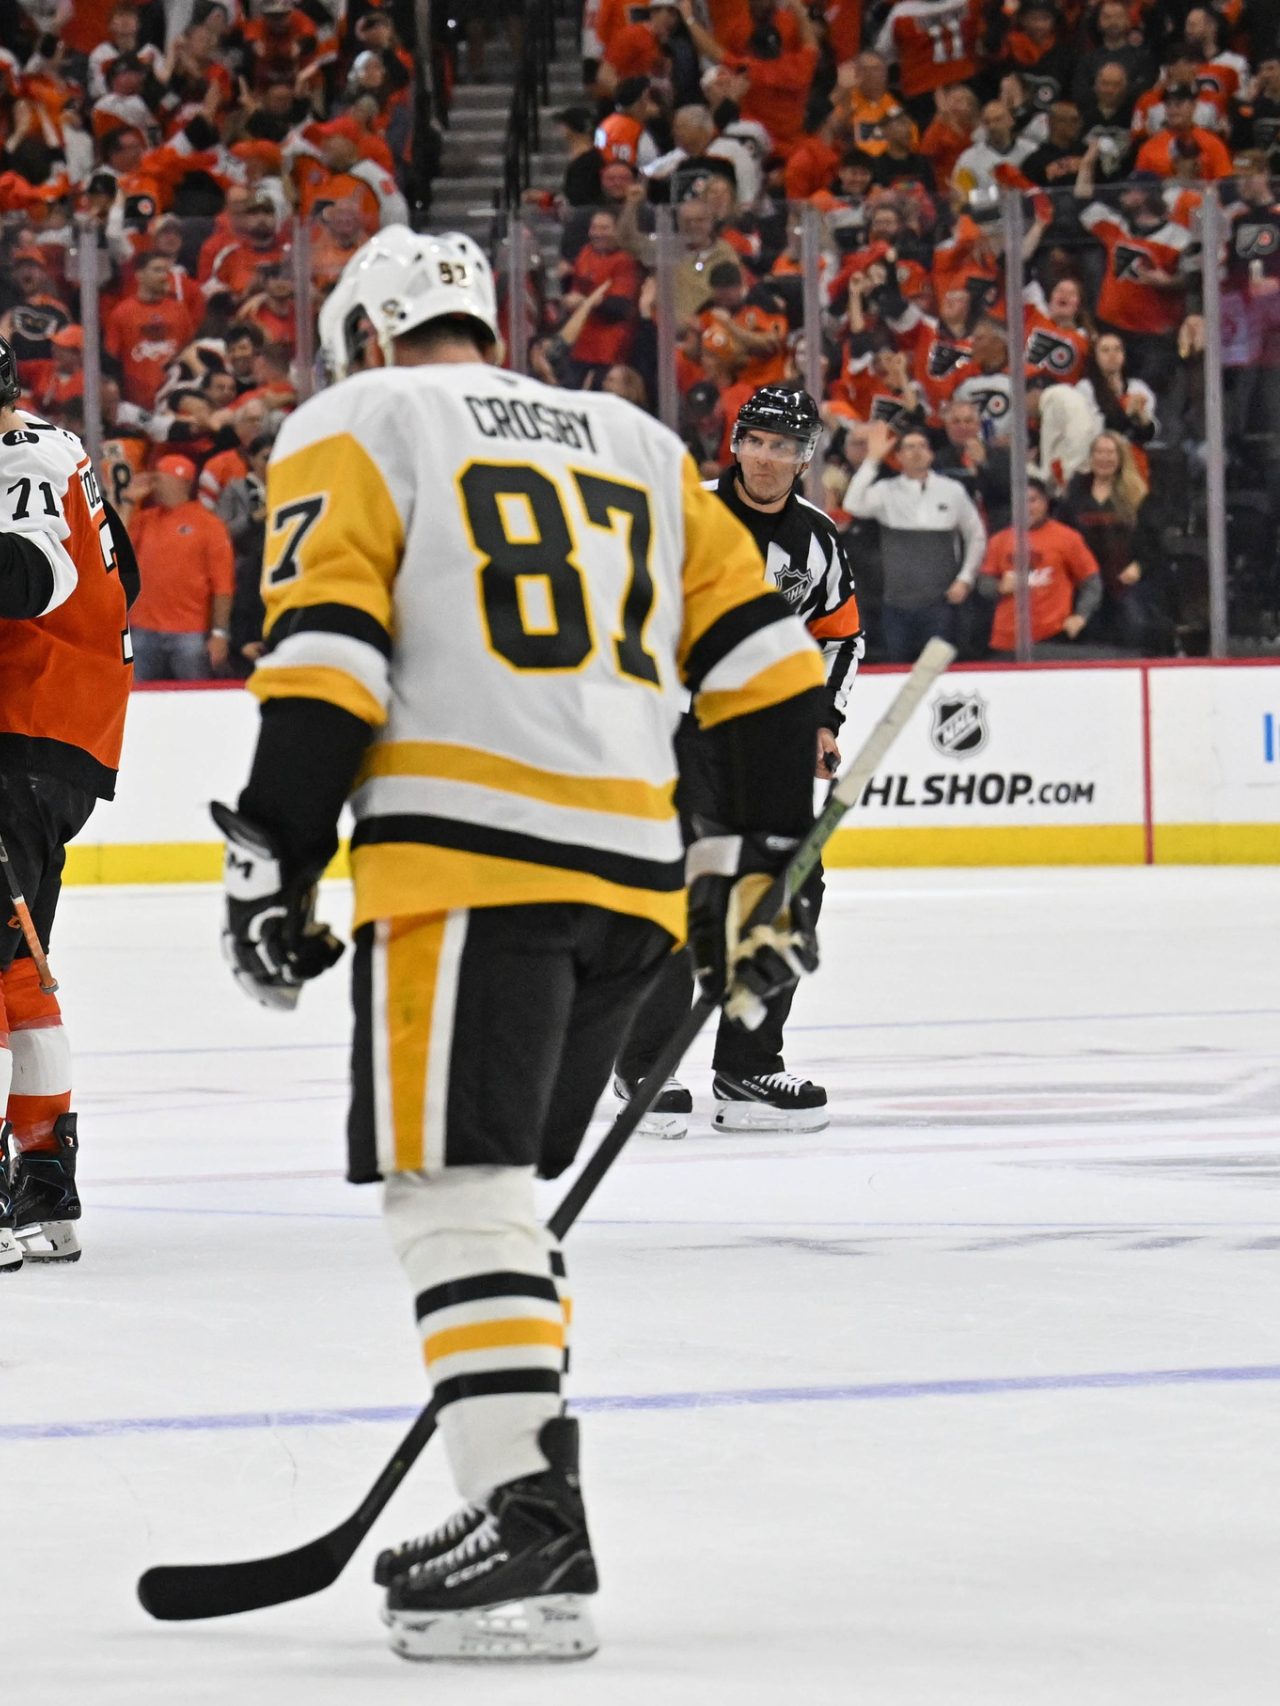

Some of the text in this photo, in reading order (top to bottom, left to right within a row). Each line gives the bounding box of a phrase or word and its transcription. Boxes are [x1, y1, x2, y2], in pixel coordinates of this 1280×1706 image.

[463, 395, 598, 455] CROSBY
[7, 477, 61, 521] 71
[457, 459, 663, 692] 87
[825, 773, 1095, 807] HLSHOP.COM
[741, 1079, 769, 1095] CCM
